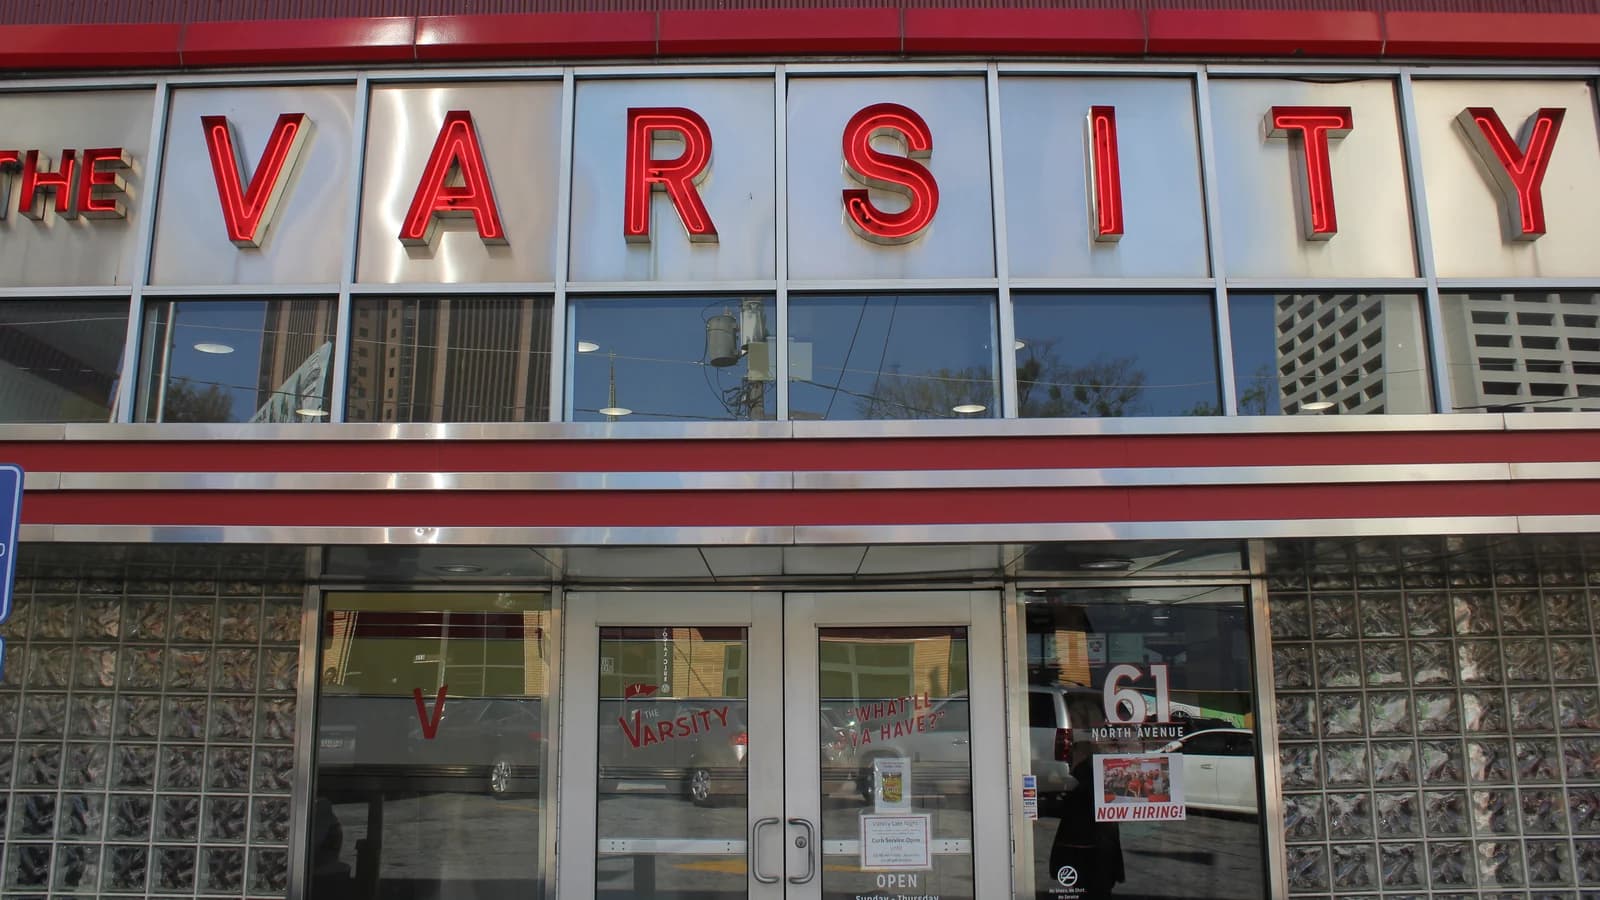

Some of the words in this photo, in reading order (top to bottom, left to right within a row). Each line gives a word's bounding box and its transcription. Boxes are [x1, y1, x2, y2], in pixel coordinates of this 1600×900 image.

[200, 103, 1566, 248] VARSITY
[1103, 663, 1170, 724] 61
[413, 684, 448, 740] V
[645, 709, 659, 719] THE
[618, 706, 729, 749] VARSITY
[1092, 728, 1131, 739] NORTH
[1137, 726, 1184, 738] AVENUE
[851, 728, 872, 747] YA
[1097, 807, 1129, 820] NOW
[1132, 805, 1184, 819] HIRING!
[876, 873, 918, 889] OPEN
